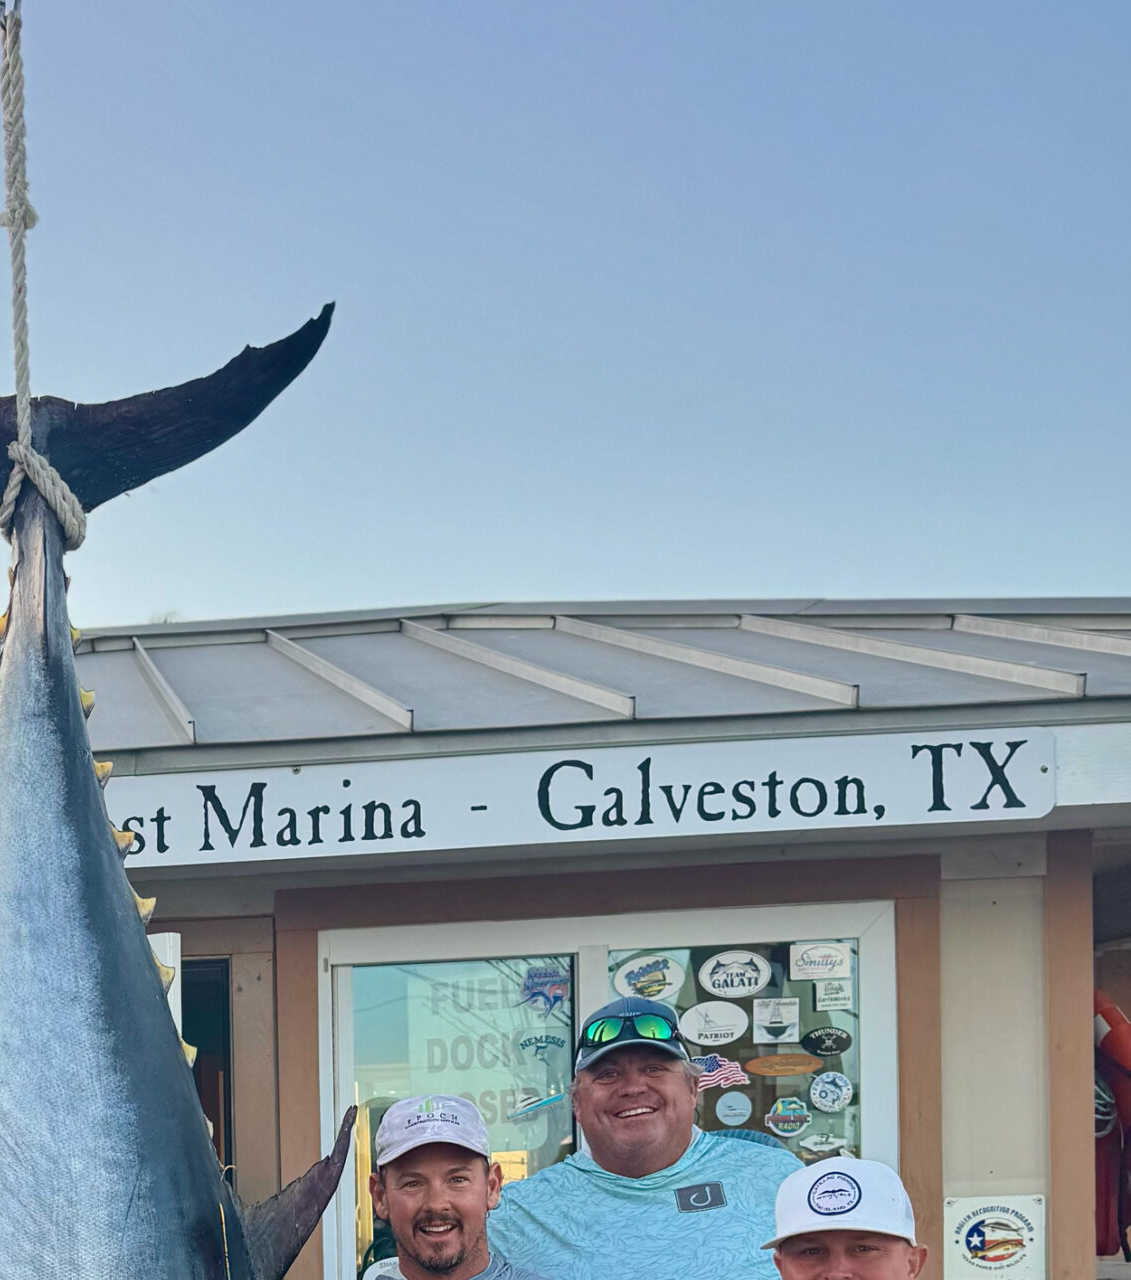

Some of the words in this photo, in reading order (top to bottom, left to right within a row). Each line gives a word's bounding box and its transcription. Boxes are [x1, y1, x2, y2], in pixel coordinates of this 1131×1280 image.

[196, 778, 426, 852] Marina
[537, 757, 886, 831] Galveston,
[911, 740, 1028, 812] TX
[712, 976, 759, 989] GALATI
[697, 1032, 735, 1040] PATRIOT
[809, 1028, 848, 1039] THUNDER
[520, 1034, 567, 1050] NEMESIS
[426, 1030, 528, 1074] DOCK
[407, 1112, 458, 1125] EPOCH
[778, 1122, 800, 1130] RADIO
[954, 1214, 972, 1235] ANGLER
[971, 1206, 1010, 1217] RECOGNITION
[1010, 1209, 1035, 1233] PROGRAM
